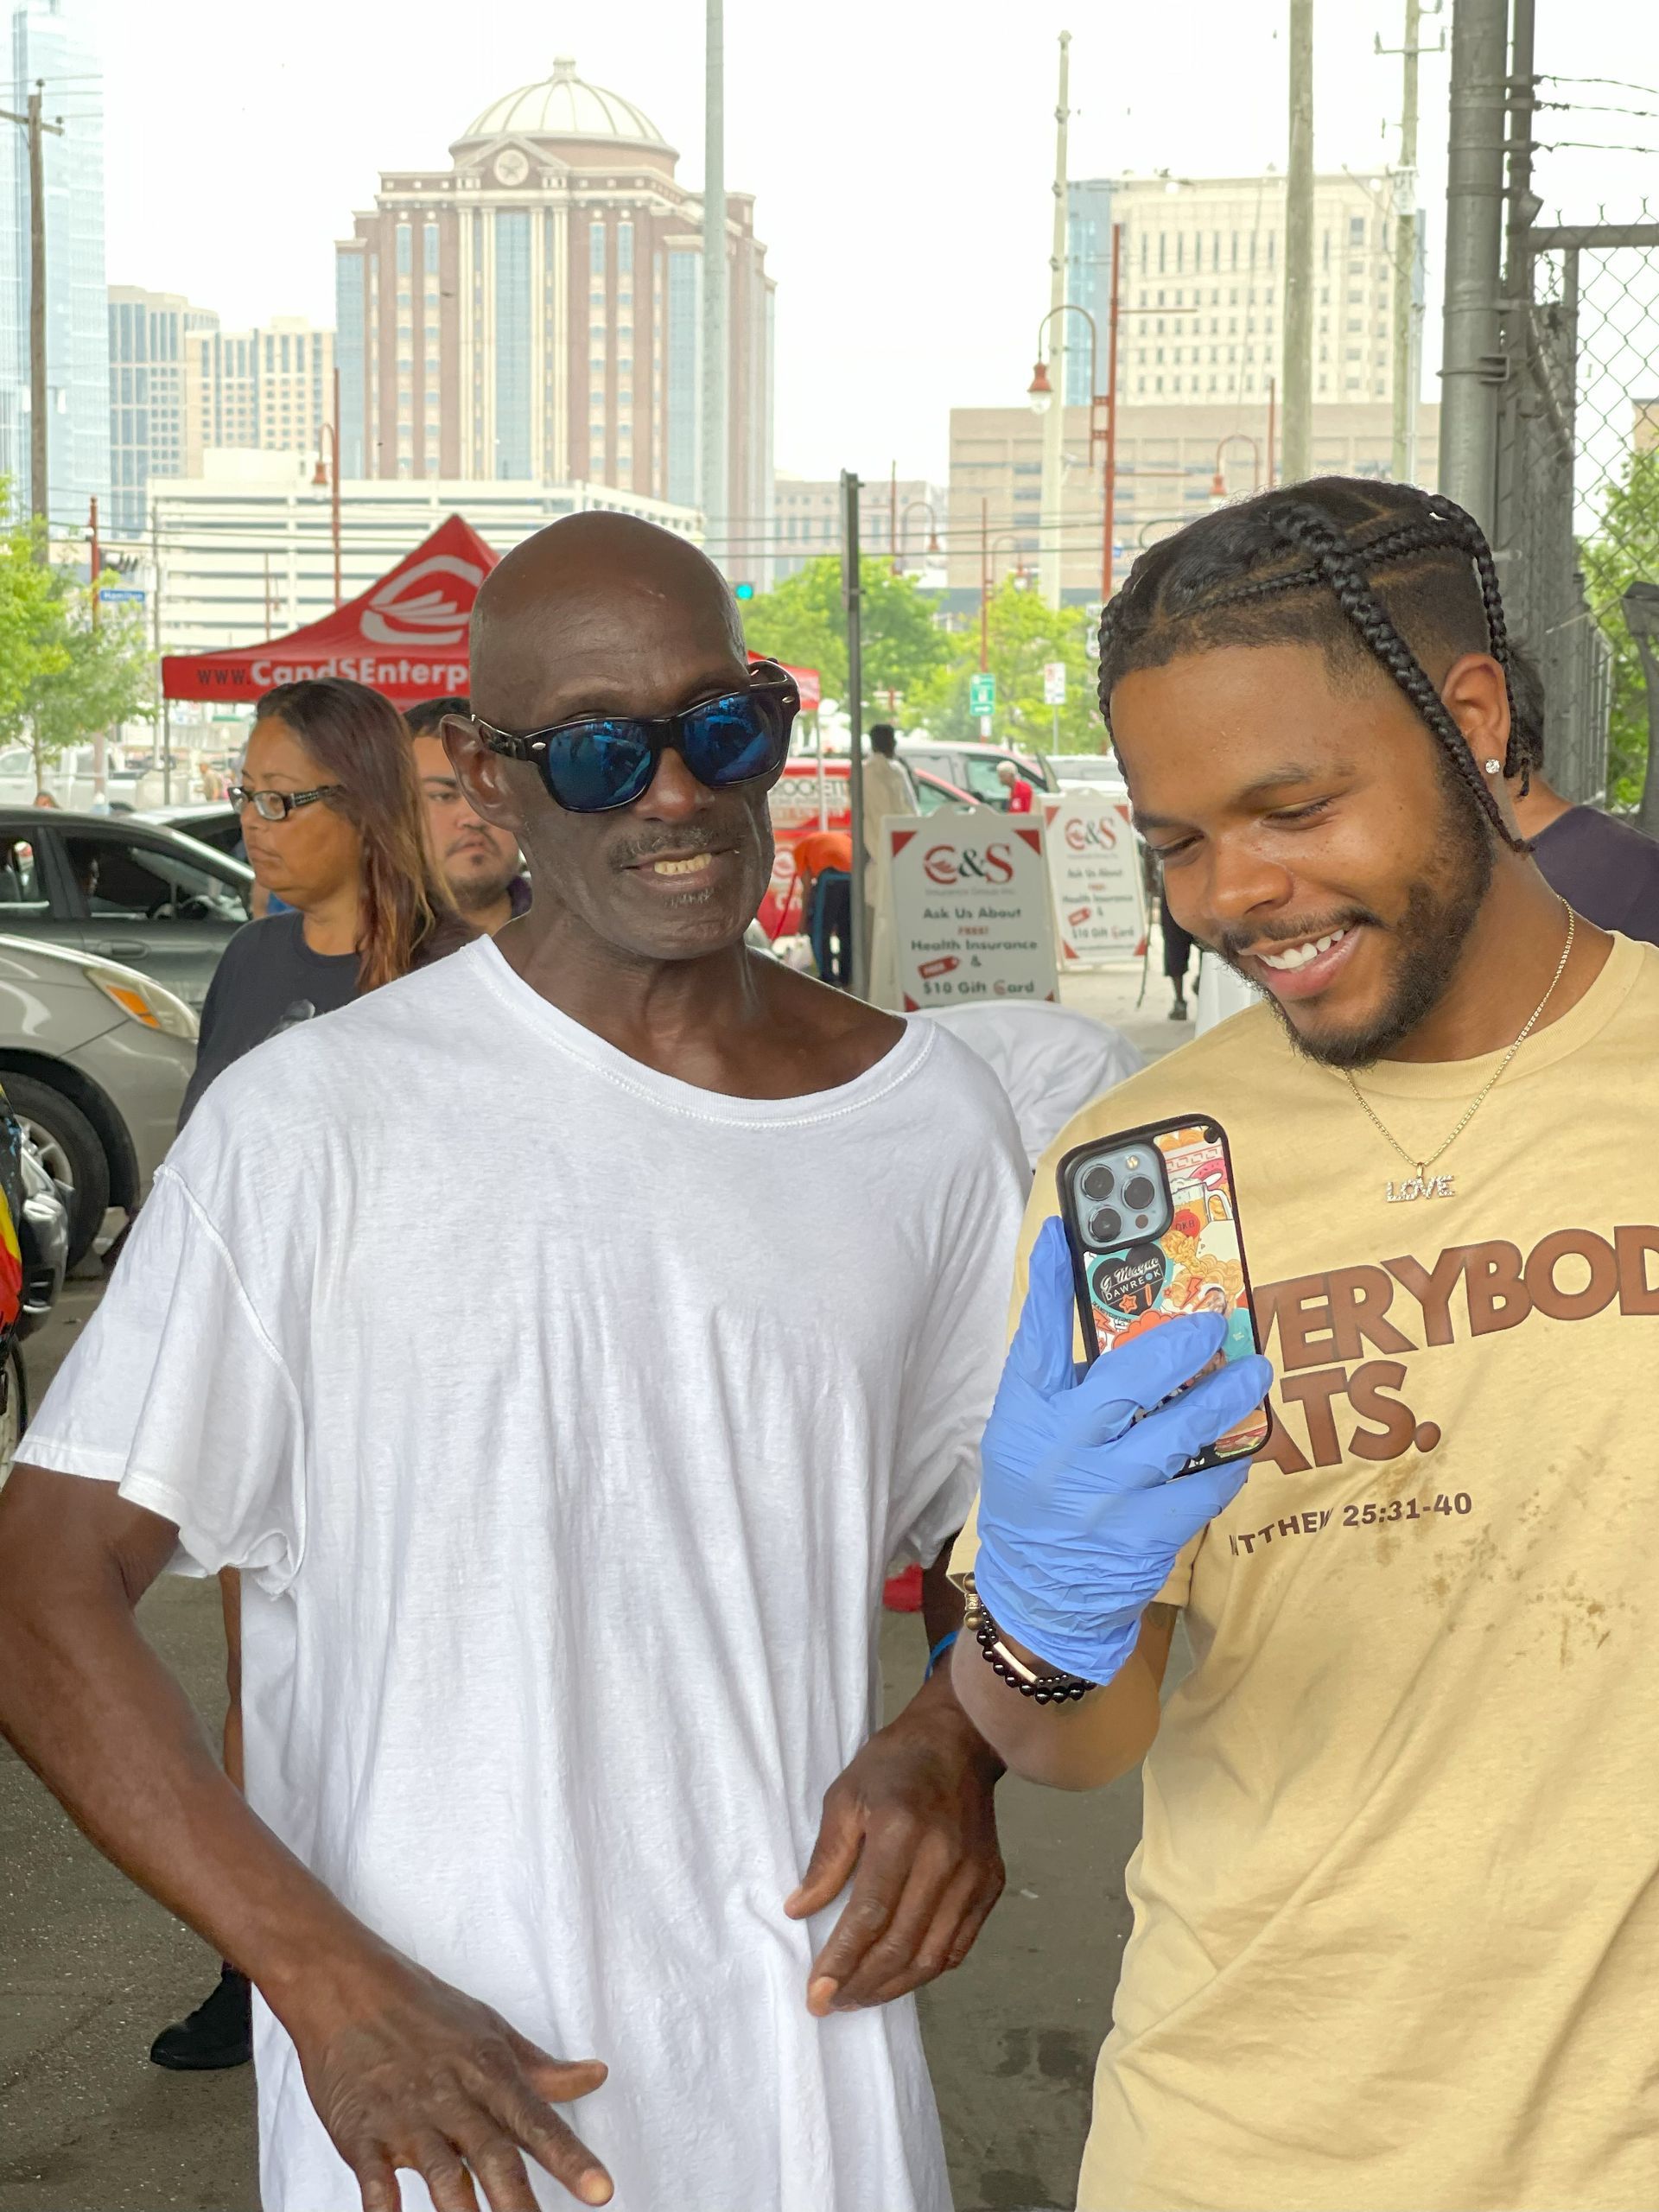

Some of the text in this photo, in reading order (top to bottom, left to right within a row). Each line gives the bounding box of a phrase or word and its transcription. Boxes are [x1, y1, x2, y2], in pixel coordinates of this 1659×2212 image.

[924, 842, 1014, 885] C&S
[924, 908, 1021, 919] Ask Us About
[911, 939, 1038, 951] Health Insurance
[923, 979, 1034, 995] $10 Gift Card
[1386, 1175, 1455, 1203] LOVE
[1343, 1492, 1472, 1527] 25:31-40
